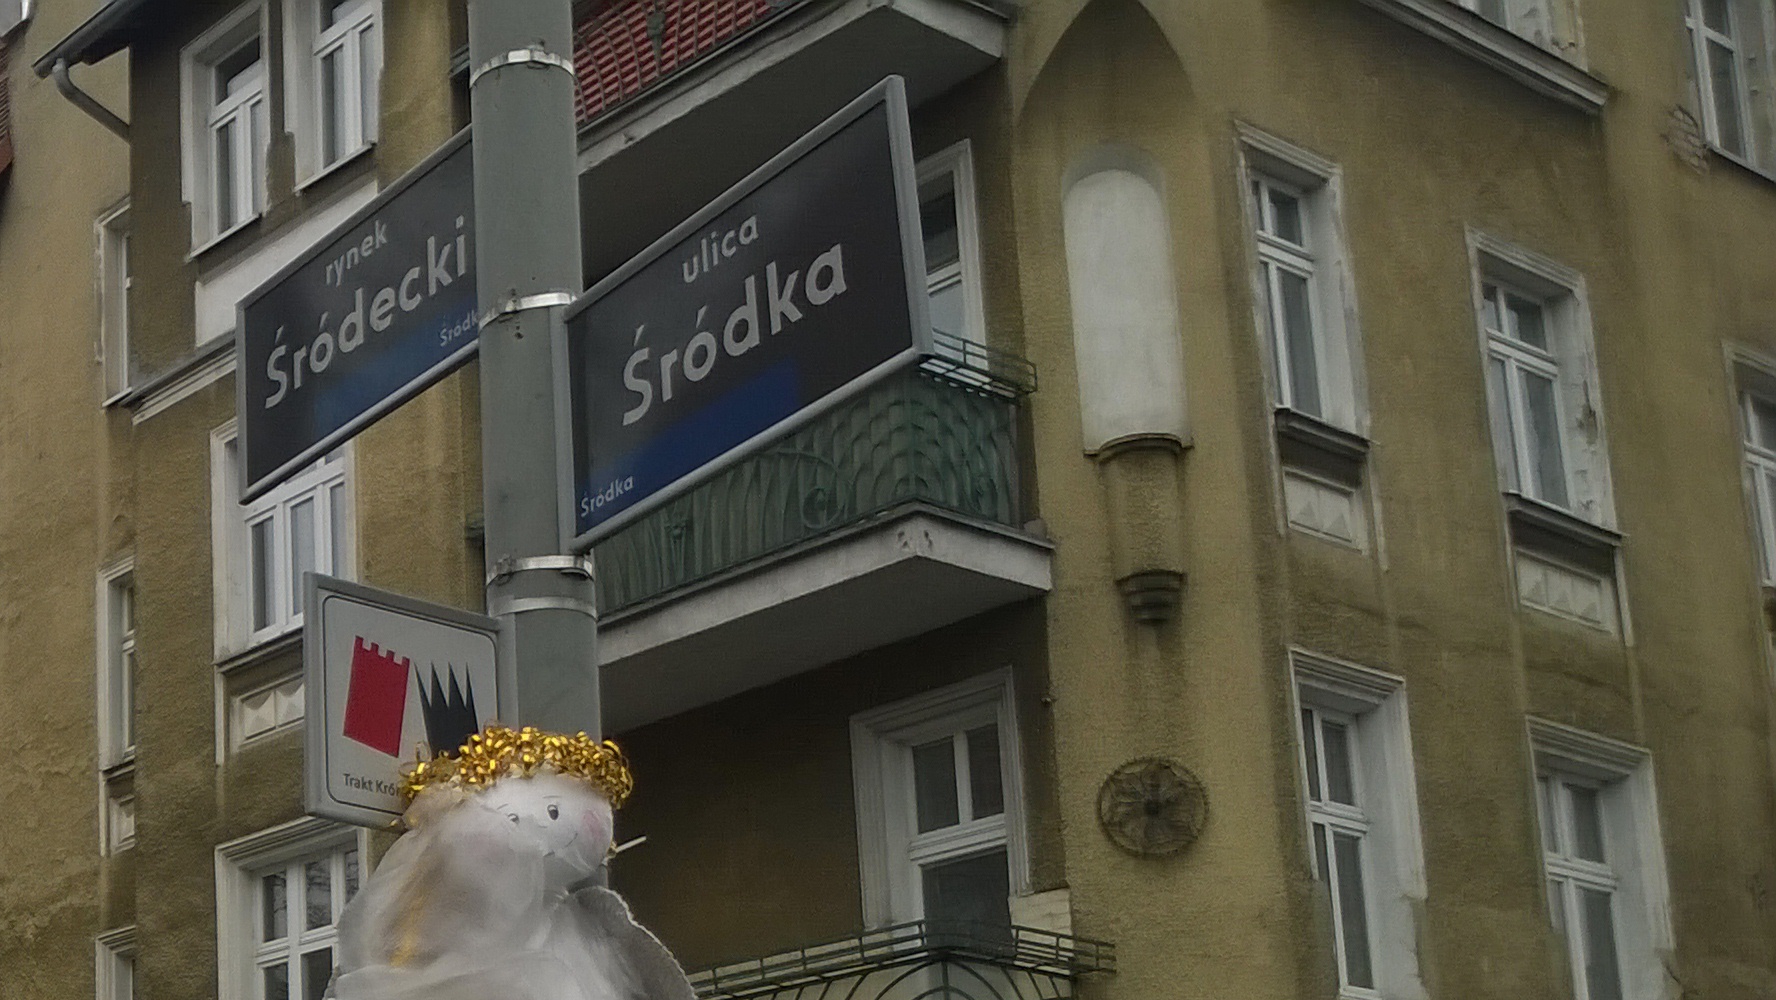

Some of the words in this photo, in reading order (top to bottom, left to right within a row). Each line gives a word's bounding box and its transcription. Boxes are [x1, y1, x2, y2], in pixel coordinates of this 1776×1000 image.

[324, 219, 389, 287] rynek
[681, 212, 760, 285] ulica
[263, 215, 469, 410] Śródecki
[621, 242, 849, 426] Śródka
[579, 475, 635, 519] Śródka
[343, 773, 373, 792] Trakt
